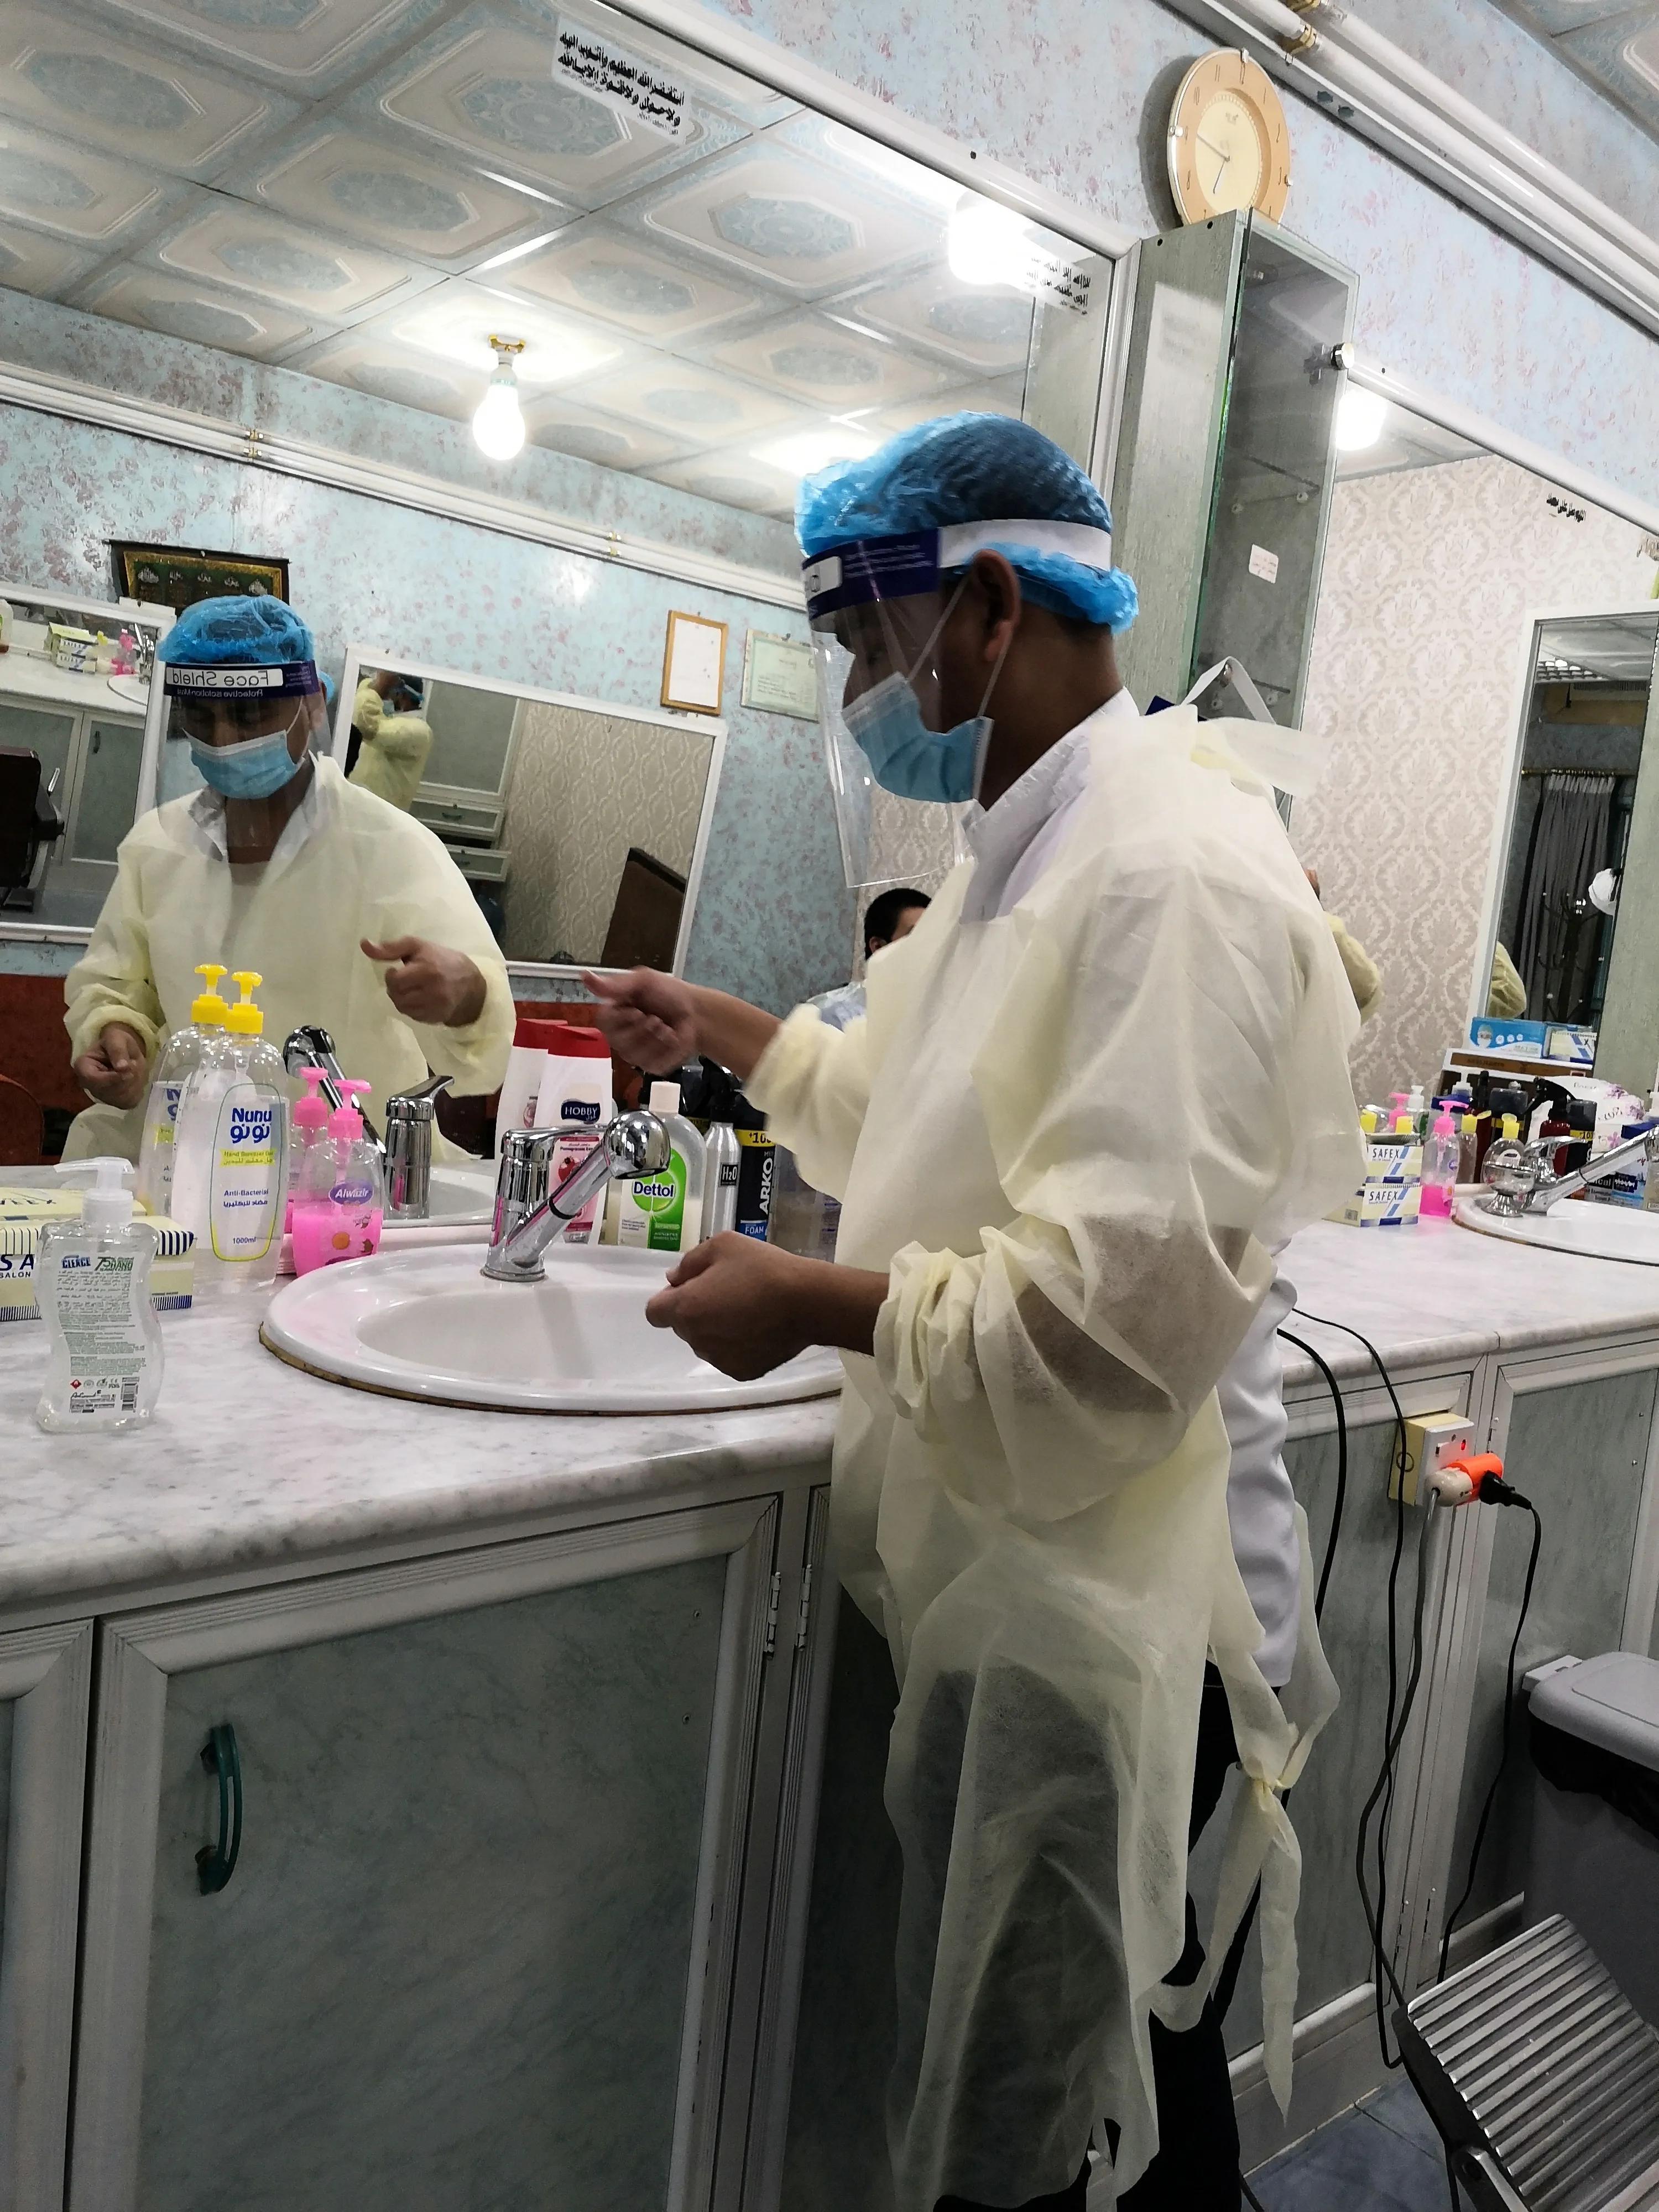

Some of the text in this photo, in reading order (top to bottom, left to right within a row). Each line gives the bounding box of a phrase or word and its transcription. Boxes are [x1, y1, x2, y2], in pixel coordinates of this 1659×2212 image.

[232, 1108, 272, 1122] Nunu
[565, 1107, 598, 1116] HOBBY
[1372, 1147, 1400, 1159] SAFEX
[634, 1181, 674, 1197] Dettol
[759, 1157, 773, 1215] ARKO
[1369, 1190, 1399, 1201] SAFEX
[745, 1225, 764, 1235] FOAM
